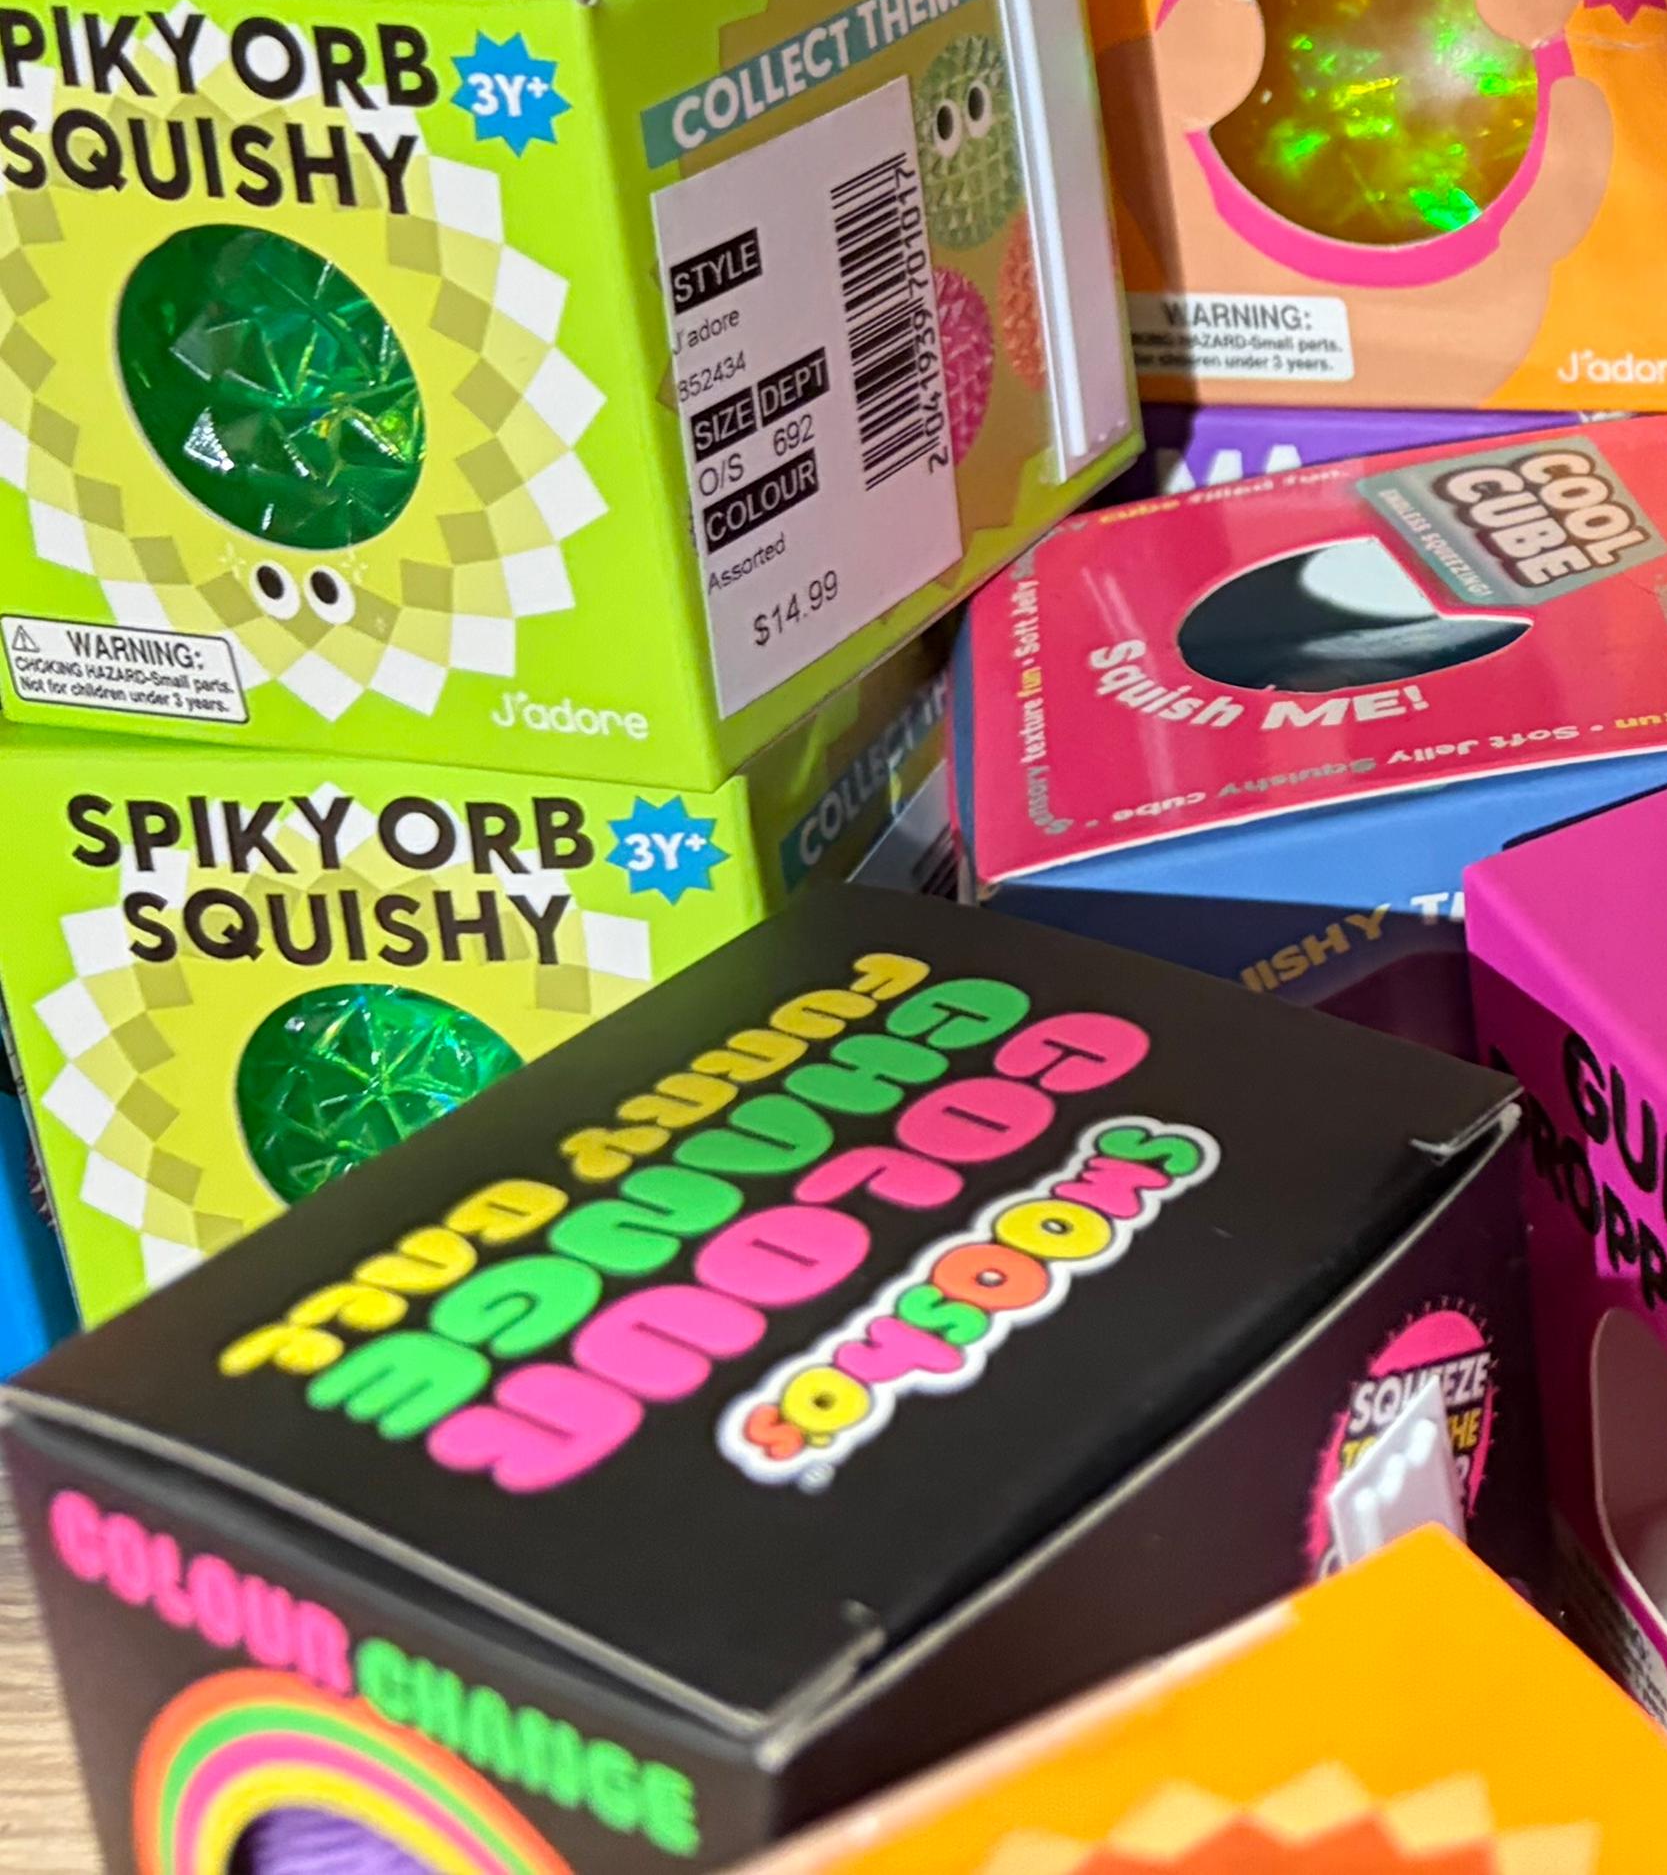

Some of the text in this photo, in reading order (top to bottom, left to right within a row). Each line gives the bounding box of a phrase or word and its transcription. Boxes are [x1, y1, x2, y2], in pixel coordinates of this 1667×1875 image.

[230, 16, 439, 111] ORB
[672, 17, 849, 150] COLLECT
[0, 111, 417, 214] SQUISHY
[674, 239, 758, 303] STYLE
[674, 308, 740, 355] J'adore
[695, 358, 826, 450] SIZE DEPT
[699, 415, 814, 497] O/S 692
[708, 462, 816, 541] COLOUR
[1447, 464, 1578, 586] CUBE
[1521, 451, 1642, 567] COOL
[708, 534, 786, 594] Assorted
[753, 570, 839, 647] $14.99
[492, 693, 649, 739] J'adore
[1089, 639, 1429, 729] Squish ME!
[67, 792, 595, 872] SPIKY ORB
[128, 891, 572, 964] SQUISHY
[307, 979, 1030, 1438] CHANGE
[427, 1012, 1150, 1493] COLOUR
[49, 1490, 701, 1853] COLOUR CHANGE
